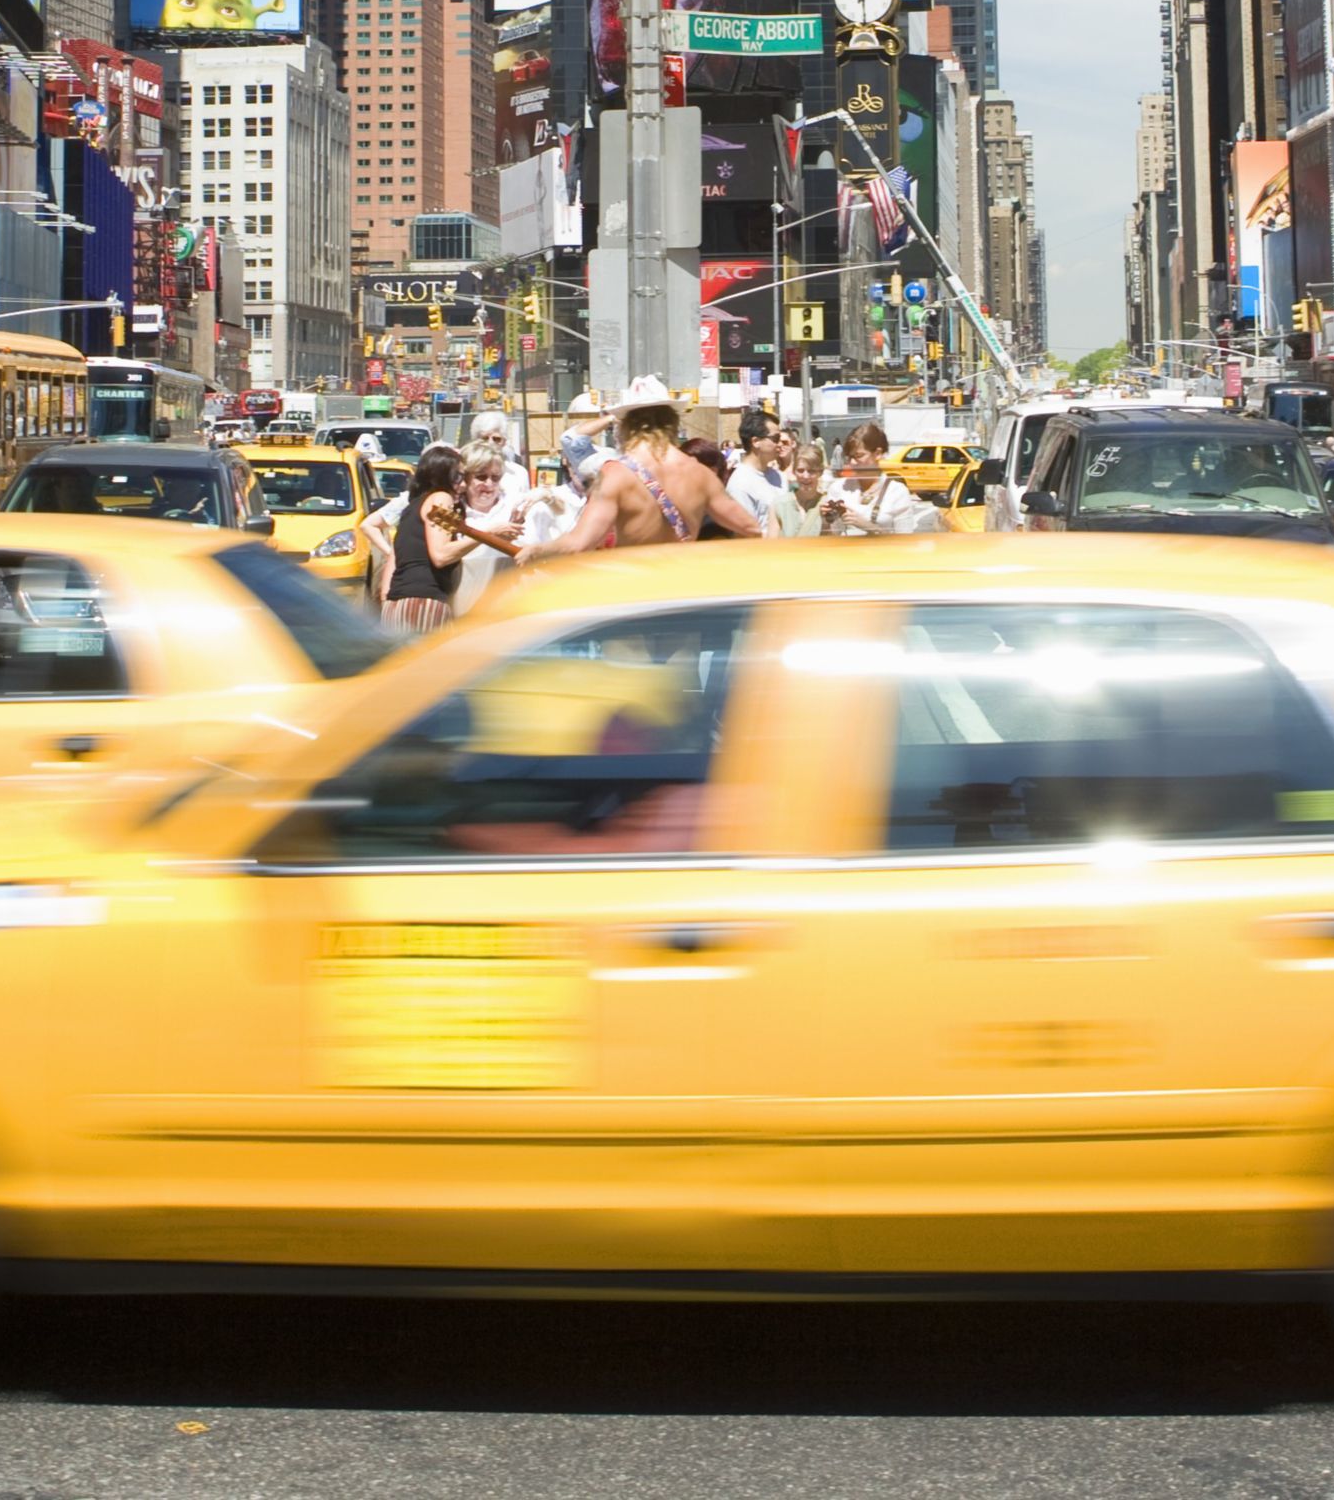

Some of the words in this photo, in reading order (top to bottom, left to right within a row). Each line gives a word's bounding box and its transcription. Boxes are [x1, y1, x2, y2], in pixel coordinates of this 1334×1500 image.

[693, 18, 750, 41] GEORGE
[755, 19, 816, 40] ABBOTT
[741, 41, 764, 52] WAY
[397, 280, 442, 302] LOT
[95, 389, 145, 399] CHARTER
